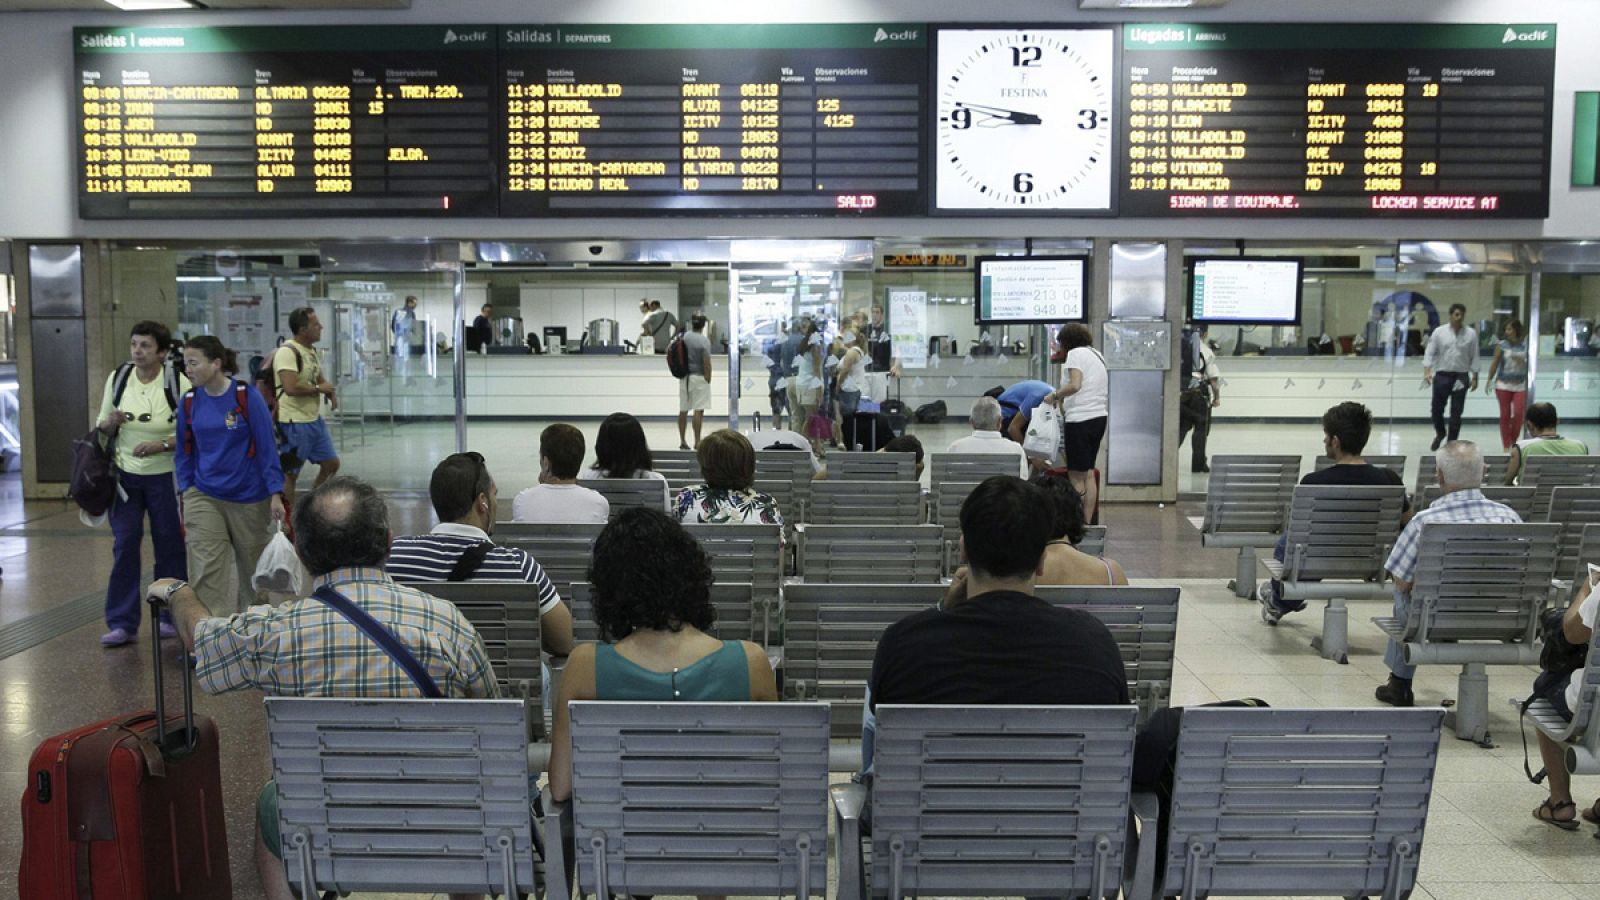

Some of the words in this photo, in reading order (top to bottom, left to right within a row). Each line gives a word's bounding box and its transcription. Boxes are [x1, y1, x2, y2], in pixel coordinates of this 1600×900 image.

[80, 33, 127, 47] Salidas
[460, 32, 488, 41] adif
[507, 30, 552, 43] Salidas
[565, 35, 611, 43] DEPARTURES
[890, 30, 918, 40] adif
[1131, 29, 1184, 43] Llegadas
[1518, 31, 1548, 41] adif
[1008, 47, 1042, 67] 12
[682, 68, 698, 76] Tren
[1173, 66, 1217, 75] Procedencia
[1442, 68, 1495, 76] Observaciones
[124, 87, 239, 99] MURCIA-CARTAGENA
[256, 87, 307, 99] ALTARIA
[508, 84, 544, 97] 11:30
[548, 84, 622, 97] VALLADOLID
[683, 84, 720, 96] AVANT
[1001, 89, 1047, 97] FESTINA
[1172, 84, 1247, 96] VALLADOLID
[1308, 84, 1345, 96] AVANT
[124, 102, 154, 115] IRUN
[256, 102, 272, 115] MD
[369, 102, 384, 115] 15
[508, 100, 544, 112] 12:20
[548, 100, 592, 112] FERROL
[683, 100, 720, 112] ALVIA
[740, 100, 778, 112] 04125
[817, 100, 840, 112] 125
[1172, 100, 1231, 112] ALBACETE
[1308, 100, 1324, 112] MD
[124, 118, 154, 130] JAEN
[256, 118, 272, 130] MD
[508, 116, 544, 128] 12:20
[548, 116, 600, 128] OURENSE
[684, 116, 720, 128] ICITY
[742, 116, 778, 128] 10125
[824, 115, 854, 128] 4125
[952, 108, 971, 129] 9
[1078, 109, 1097, 129] 3
[1172, 116, 1202, 128] LEON
[1308, 116, 1345, 128] ICITY
[124, 133, 196, 145] VALLADOLID
[257, 134, 294, 145] AVANT
[508, 132, 544, 144] 12:22
[549, 132, 579, 144] IRUN
[683, 132, 698, 143] MD
[1171, 131, 1245, 143] VALLADOLID
[1307, 132, 1345, 143] AVANT
[125, 149, 190, 161] LEON-VIGO
[258, 149, 294, 160] ICITY
[509, 148, 544, 159] 12:32
[549, 148, 586, 159] CADIZ
[683, 147, 720, 159] ALVIA
[740, 147, 778, 159] 04070
[1171, 147, 1245, 159] VALLADOLID
[1307, 147, 1330, 159] AVE
[125, 164, 212, 176] OVIEDO-GIJON
[257, 164, 295, 176] ALVIA
[314, 164, 351, 176] 04111
[509, 163, 544, 175] 12:34
[549, 163, 665, 175] MURCIA-CARTAGENA
[683, 163, 735, 175] ALTARIA
[1171, 163, 1223, 175] VITORIA
[1307, 163, 1344, 175] ICITY
[87, 180, 122, 192] 11:14
[125, 180, 191, 192] SALAMANCA
[258, 180, 273, 192] MD
[549, 178, 593, 191] CIUDAD
[599, 178, 629, 191] REAL
[683, 178, 699, 190] MD
[1013, 173, 1033, 193] 6
[1170, 178, 1229, 190] PALENCIA
[1305, 178, 1322, 190] MD
[837, 196, 876, 208] SALID
[1213, 196, 1229, 207] DE
[1235, 196, 1300, 207] EQUIPAJE.
[1372, 196, 1417, 208] LOCKER
[1424, 196, 1475, 208] SERVICE
[1481, 196, 1497, 208] AT
[1033, 290, 1056, 300] 213
[1063, 290, 1077, 300] 04
[1033, 304, 1056, 315] 948
[1063, 304, 1078, 314] 04
